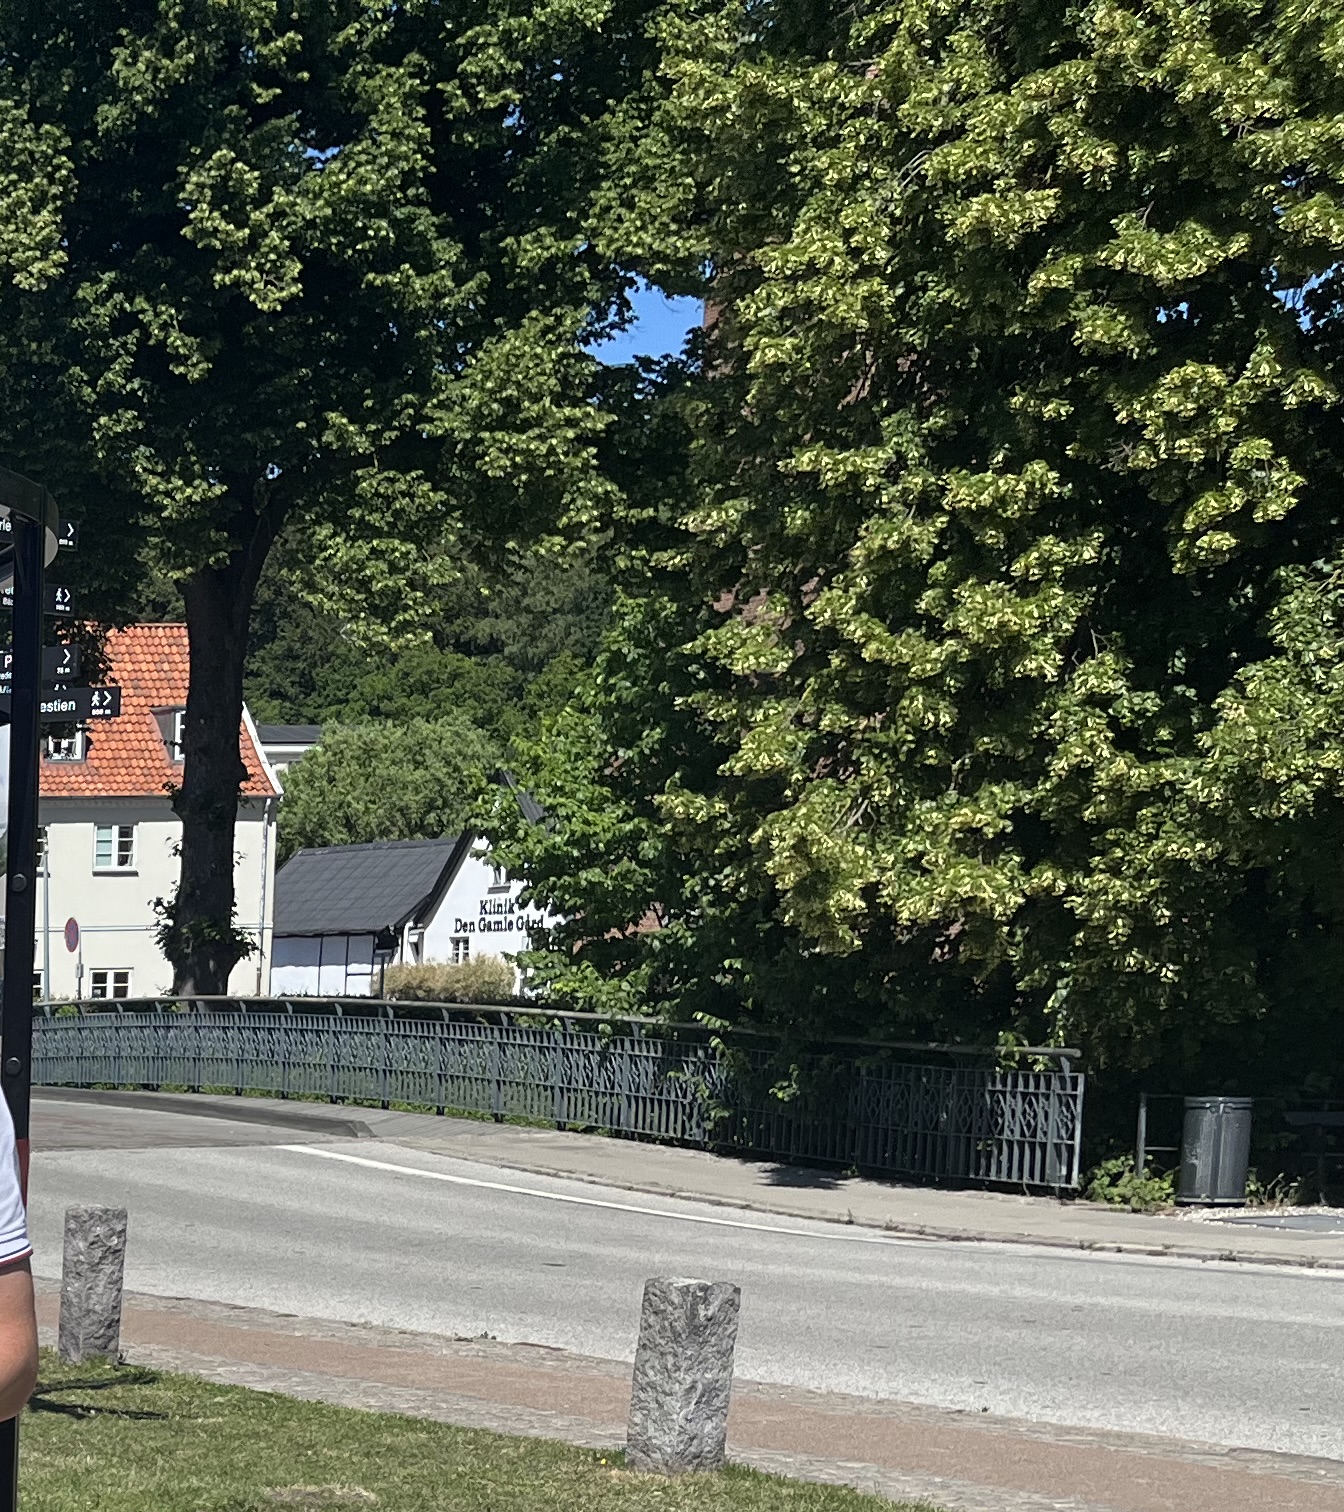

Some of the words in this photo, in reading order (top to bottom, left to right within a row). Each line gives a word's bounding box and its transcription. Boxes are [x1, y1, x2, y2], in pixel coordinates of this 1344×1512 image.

[479, 898, 515, 915] Klinik
[454, 918, 475, 933] Den
[478, 916, 514, 933] Gamle
